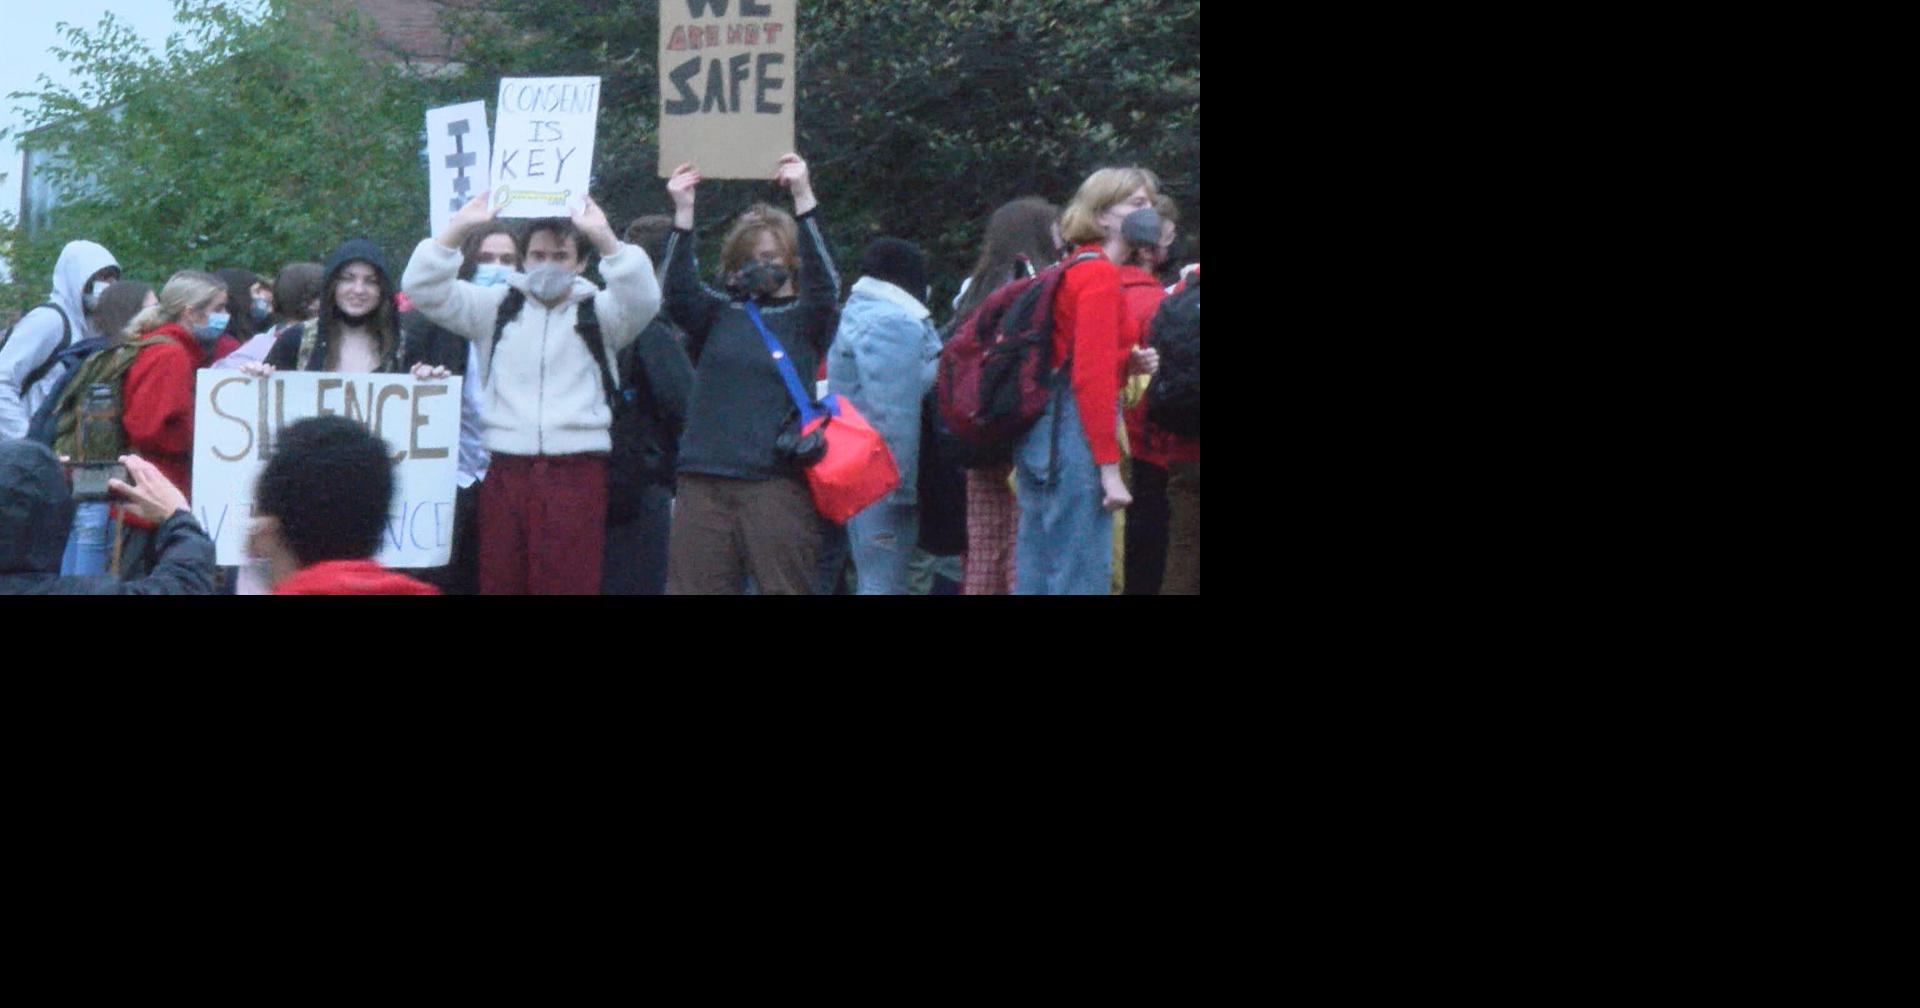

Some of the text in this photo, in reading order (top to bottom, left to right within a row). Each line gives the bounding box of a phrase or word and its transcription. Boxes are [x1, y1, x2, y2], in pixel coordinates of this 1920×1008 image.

[666, 22, 783, 51] ARE NOT
[502, 82, 598, 114] CONSENT
[664, 52, 785, 115] SAFE
[528, 120, 562, 143] IS
[500, 146, 576, 184] KEY
